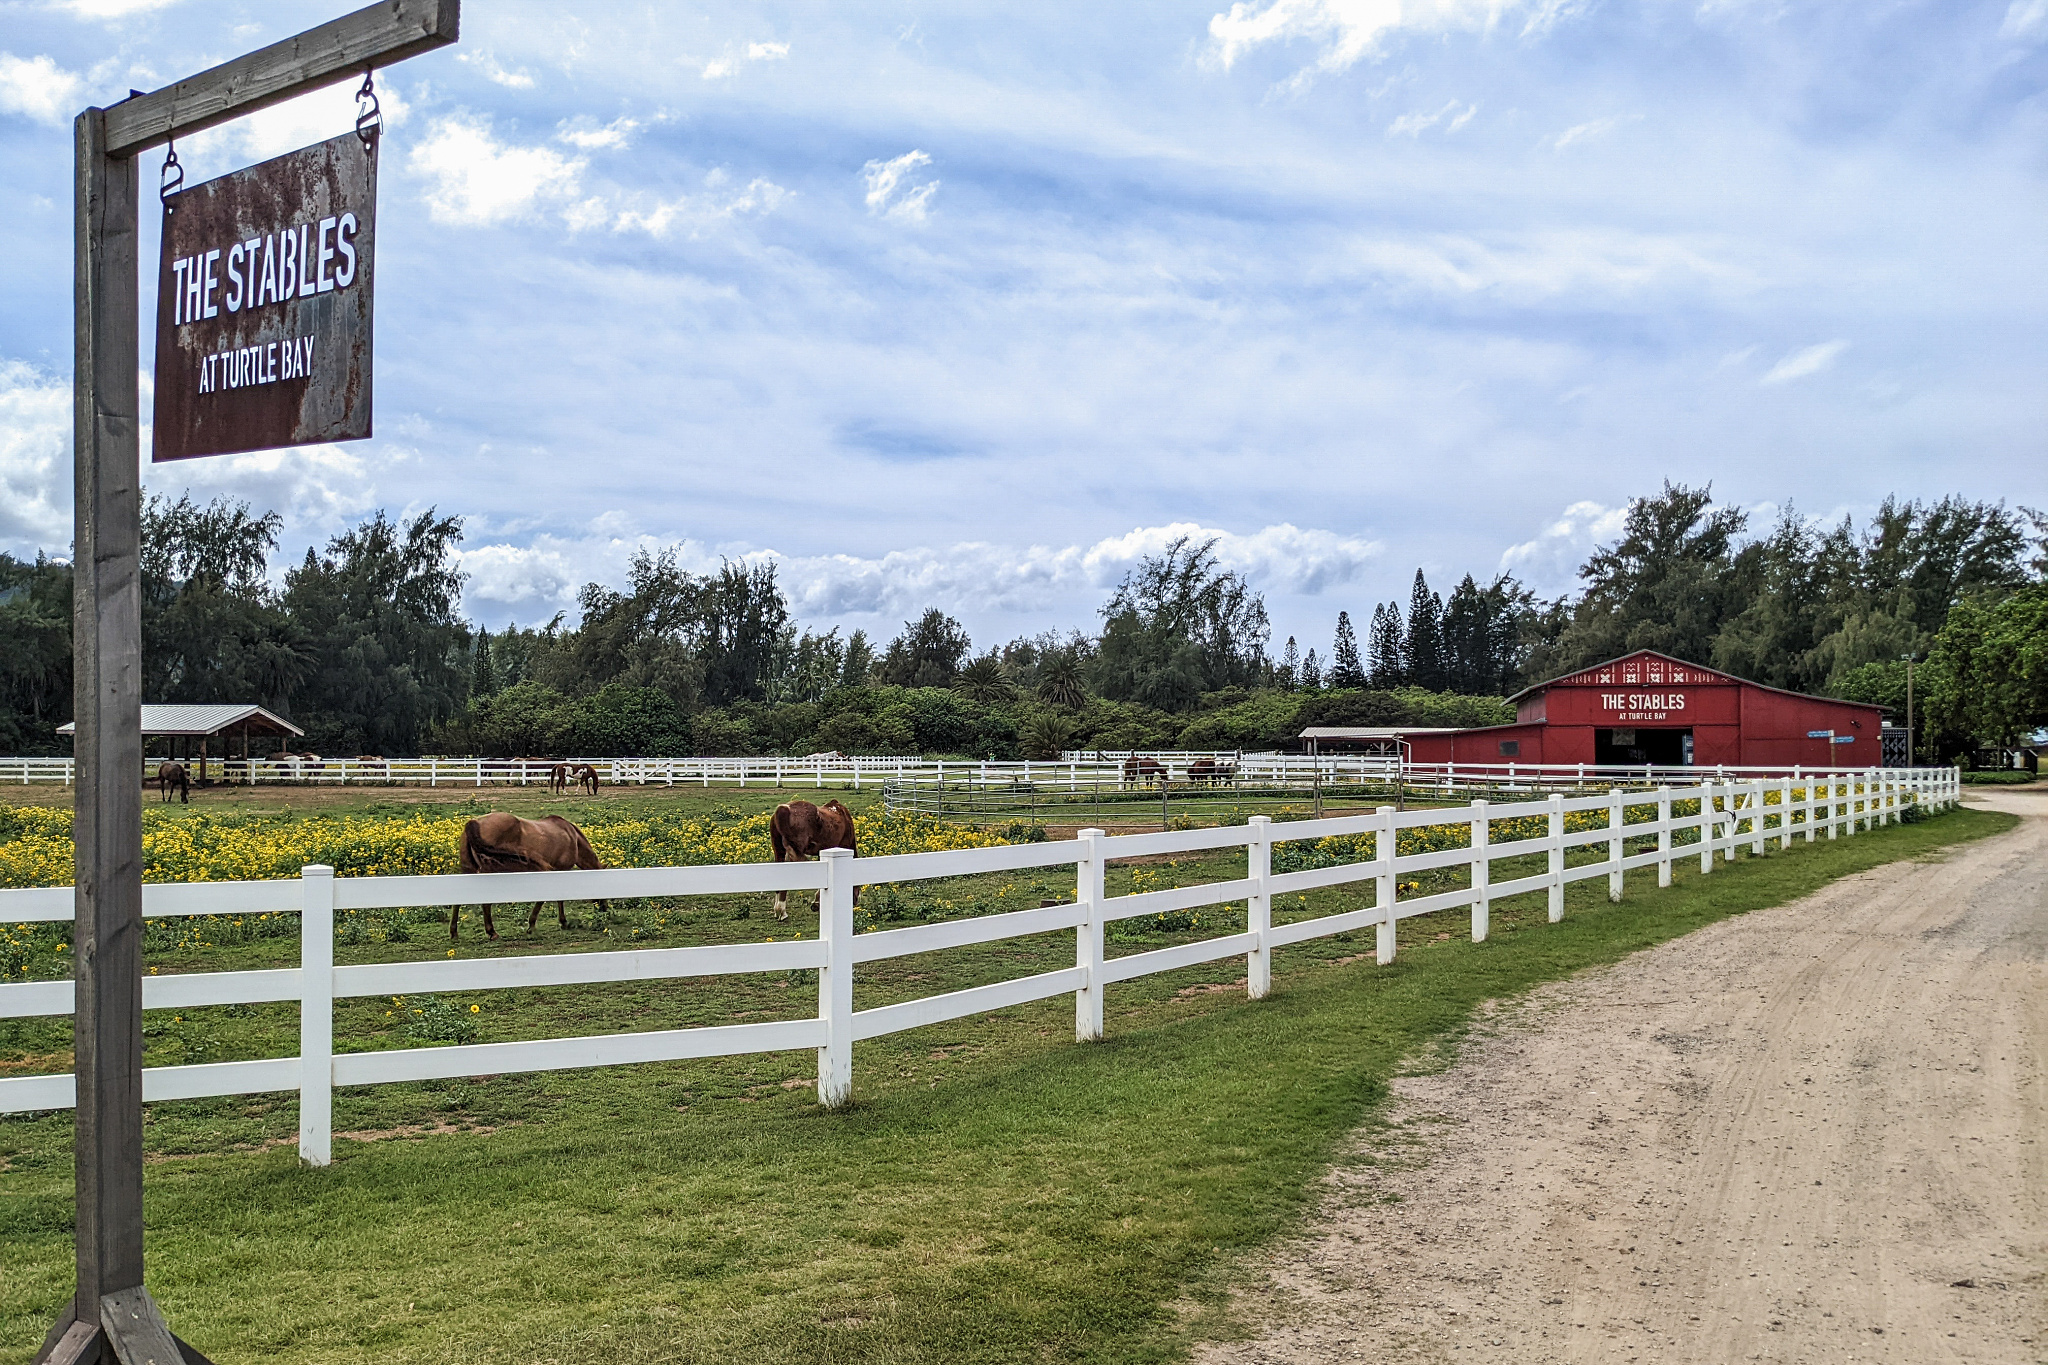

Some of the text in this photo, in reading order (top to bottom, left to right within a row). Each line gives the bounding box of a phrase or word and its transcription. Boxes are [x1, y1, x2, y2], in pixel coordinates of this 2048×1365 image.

[172, 212, 357, 326] THE STABLES
[199, 335, 315, 394] AT TURTLE BAY
[1601, 694, 1685, 710] THE STABLES
